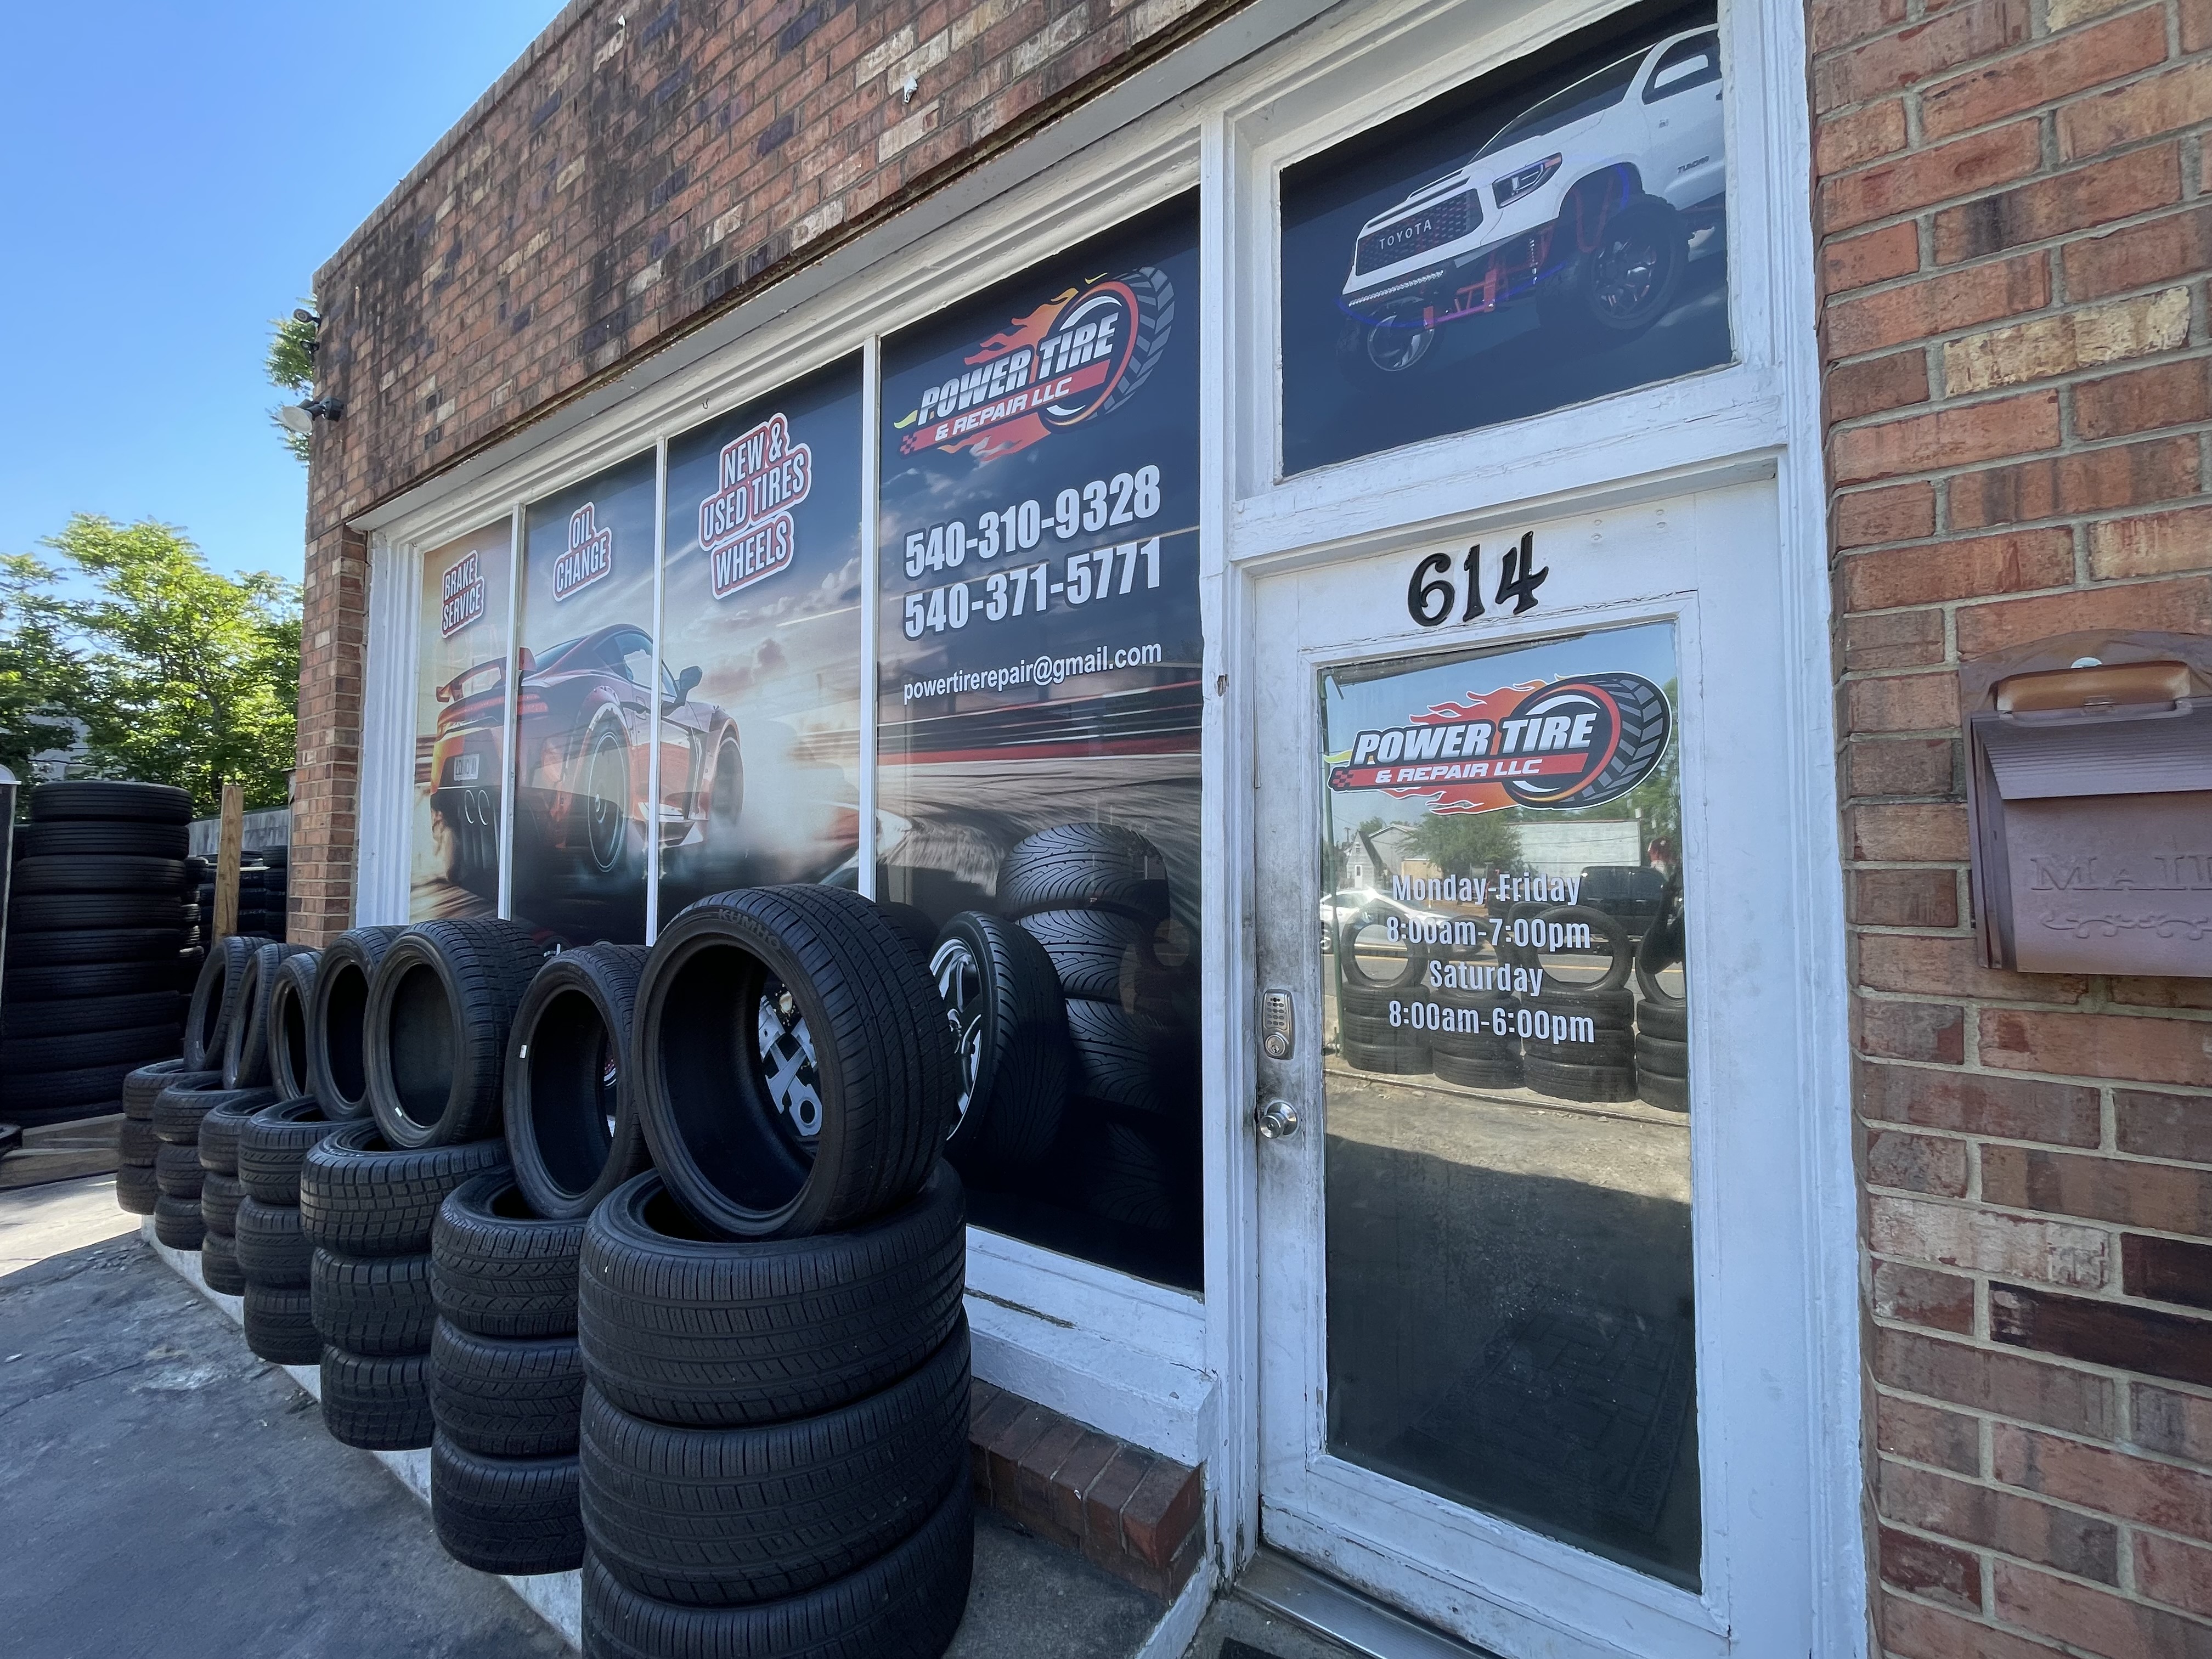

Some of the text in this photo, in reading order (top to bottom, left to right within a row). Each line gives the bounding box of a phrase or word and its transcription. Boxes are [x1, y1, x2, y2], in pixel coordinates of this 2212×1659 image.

[1379, 219, 1432, 250] TOYOTA
[917, 312, 1119, 425] POWER TIRE
[935, 377, 1072, 441] & REPAIR LLC
[725, 422, 782, 489] NEW &
[703, 453, 804, 541] USED TIRES
[906, 464, 1160, 577] 540-310-9328
[572, 511, 592, 549] OIL
[716, 521, 786, 589] WHEELS
[444, 557, 474, 601] BRAKE
[556, 536, 607, 592] CHANGE
[906, 537, 1160, 638] 540-371-5771
[1408, 531, 1549, 627] 614
[443, 583, 481, 630] SERVICE
[904, 643, 1162, 705] powertirerepair@gmail.com
[1353, 713, 1598, 765] POWER TIRE
[1375, 759, 1543, 783] & REPAIR LLC
[1392, 872, 1582, 906] Monday-Friday
[718, 909, 780, 951] KUMHO
[1387, 917, 1592, 952] 8:00am-7:00pm
[1429, 960, 1543, 997] Saturday
[1389, 1000, 1594, 1044] 8:00am-6:00pm
